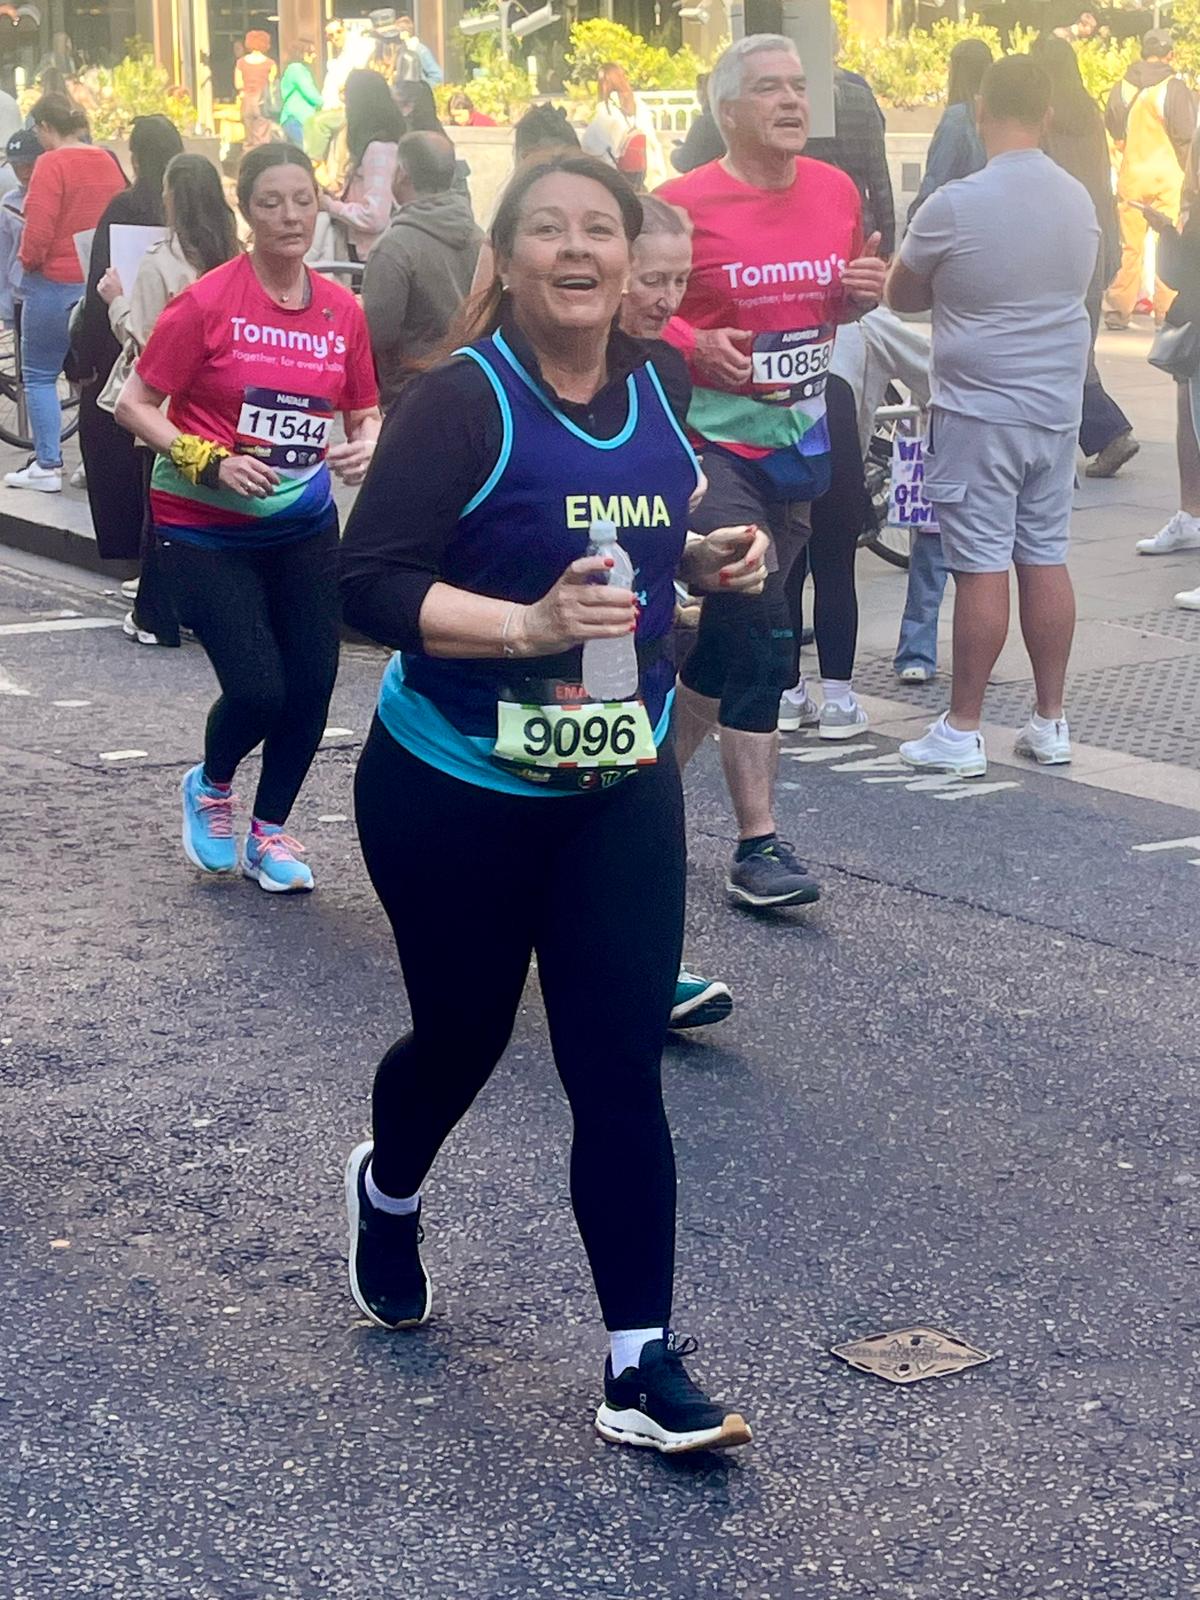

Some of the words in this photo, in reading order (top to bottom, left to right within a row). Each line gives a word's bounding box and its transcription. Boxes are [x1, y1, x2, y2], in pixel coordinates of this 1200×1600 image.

[722, 253, 846, 289] Tommy's
[230, 317, 346, 359] Tommy's
[761, 344, 831, 380] 10858
[249, 410, 326, 444] 11544
[565, 494, 671, 529] EMMA
[522, 714, 636, 758] 9096
